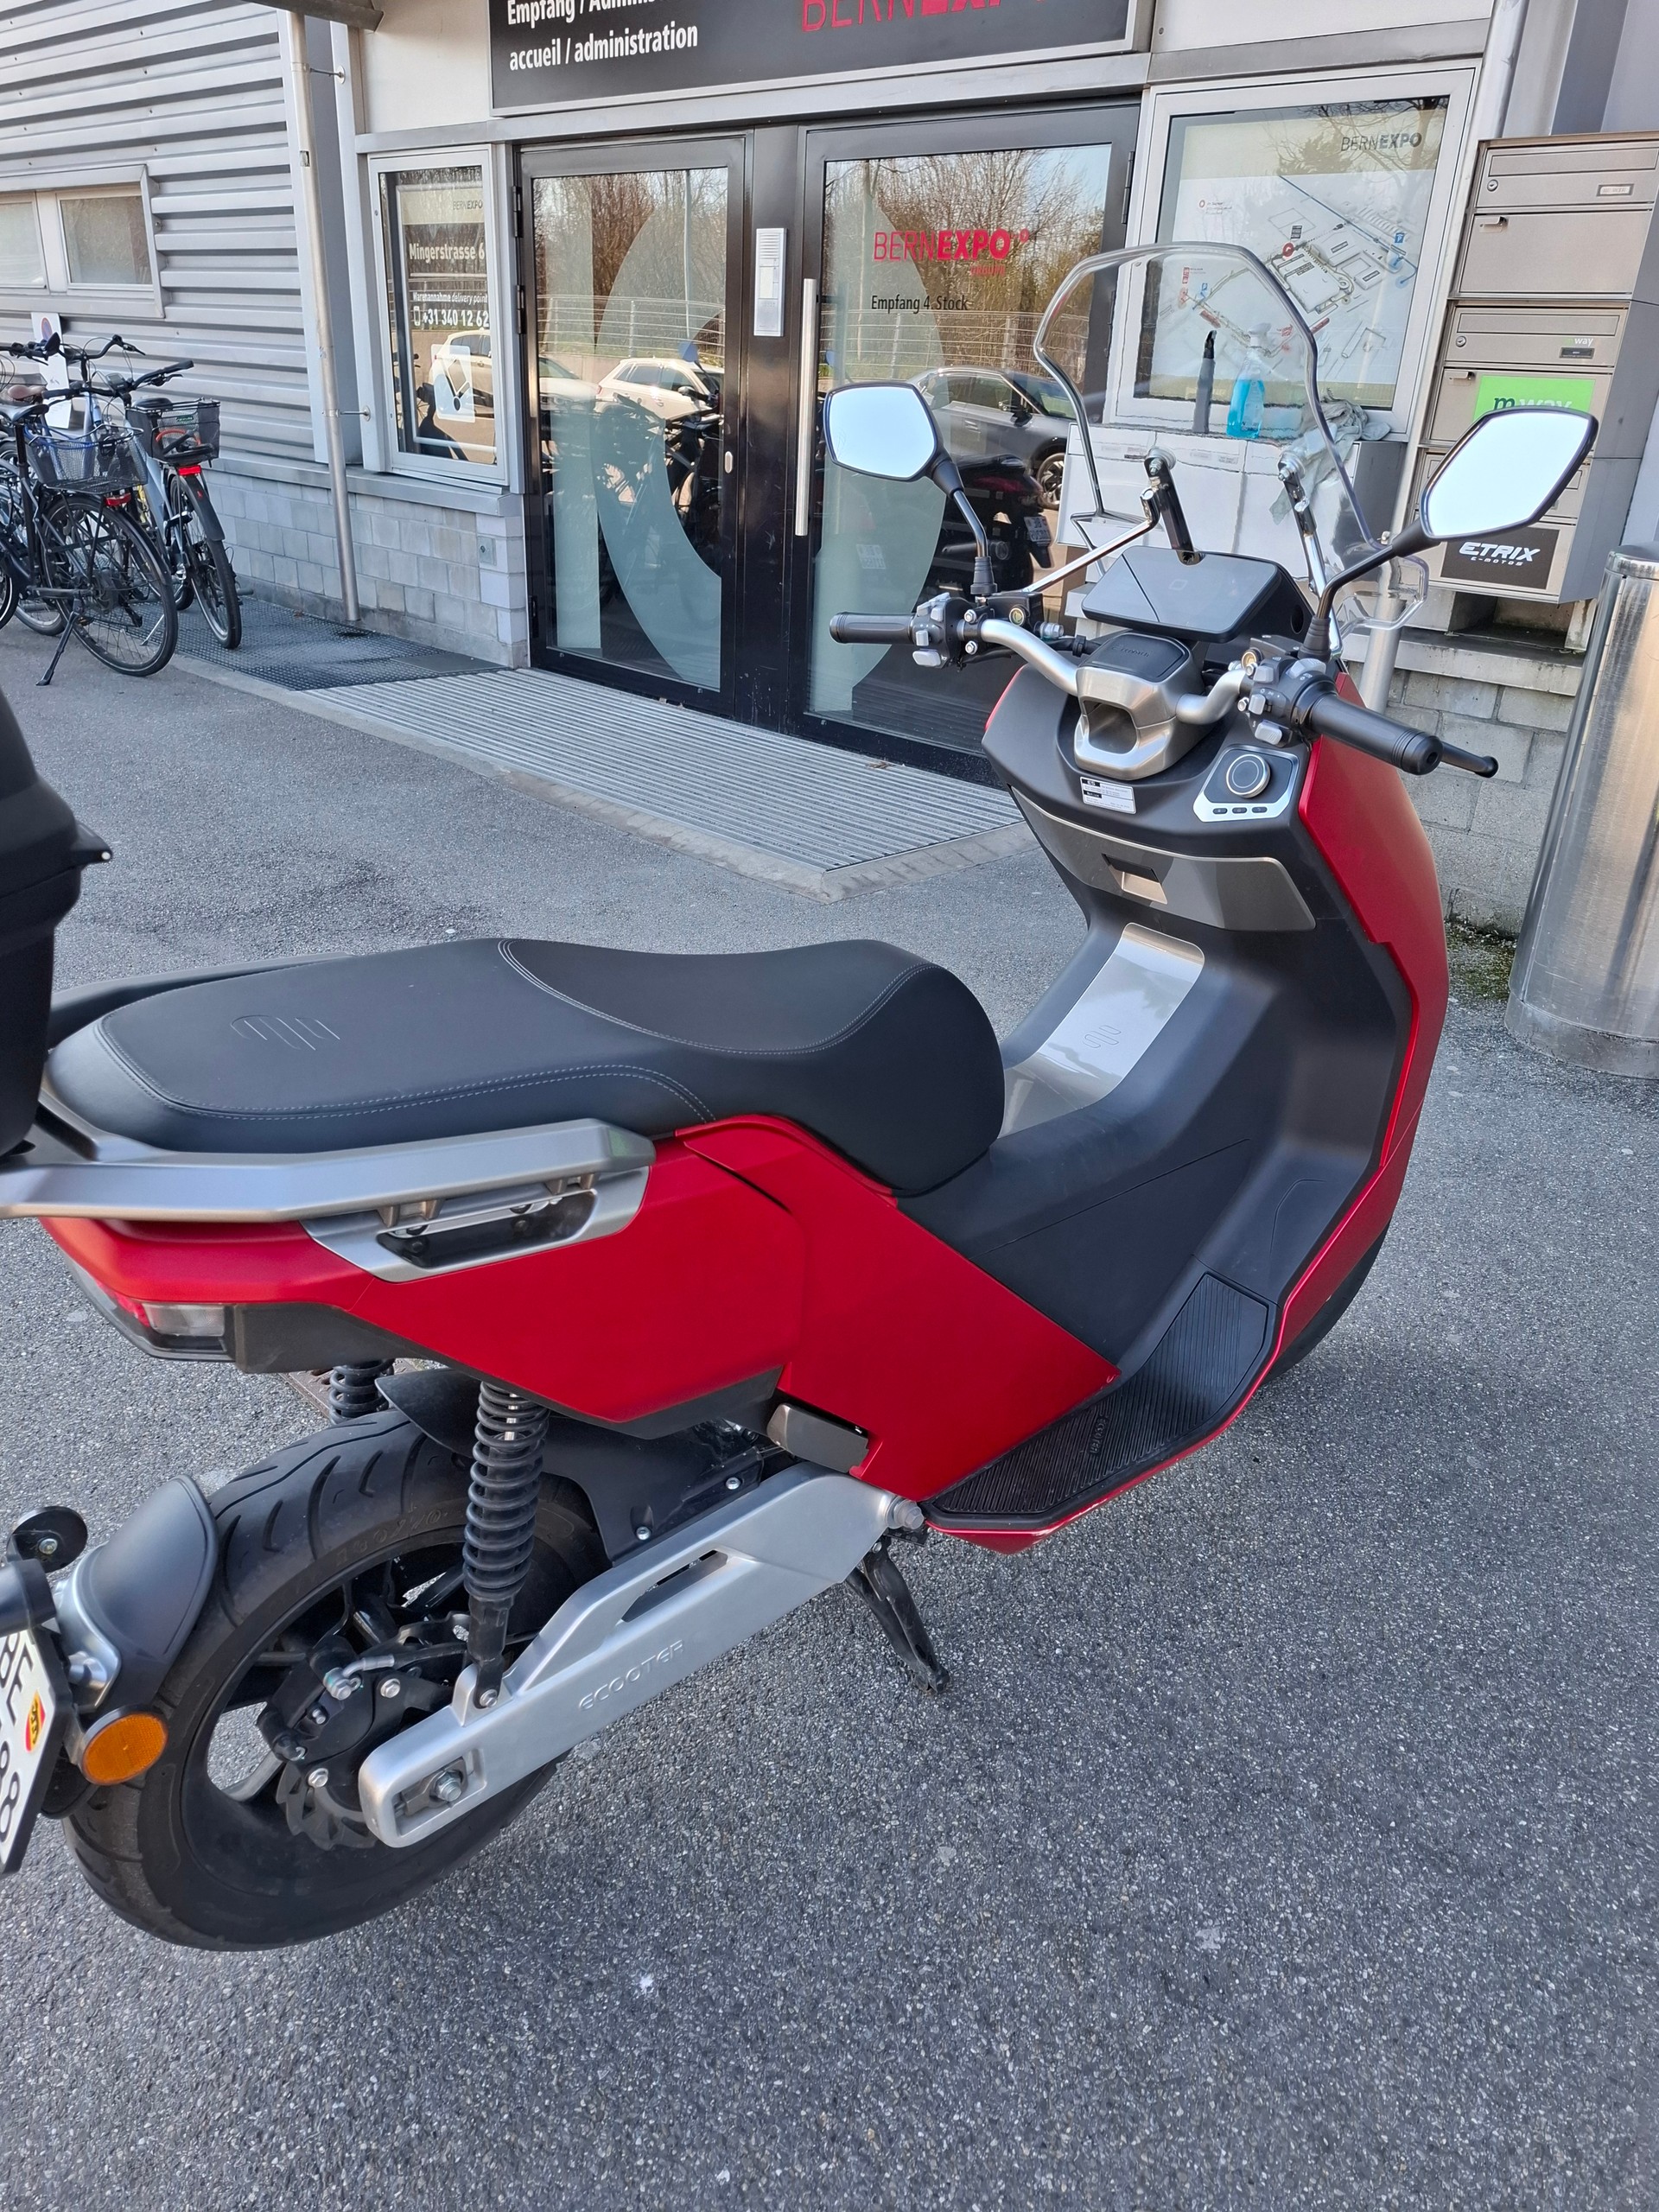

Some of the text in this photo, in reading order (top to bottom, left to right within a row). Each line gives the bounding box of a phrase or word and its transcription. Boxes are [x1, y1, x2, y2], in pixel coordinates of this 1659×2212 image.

[509, 20, 698, 71] accueil / administration
[1341, 132, 1422, 152] BERNEXPO
[409, 242, 486, 264] Mingerstrasse 6
[874, 228, 1010, 261] BERNEXPO
[451, 292, 473, 305] delivery
[871, 294, 920, 314] Empfang
[937, 295, 968, 311] Stock
[423, 308, 490, 327] +31 340 12 62
[1459, 541, 1541, 562] ETRIX
[578, 1639, 683, 1712] ECOOTER
